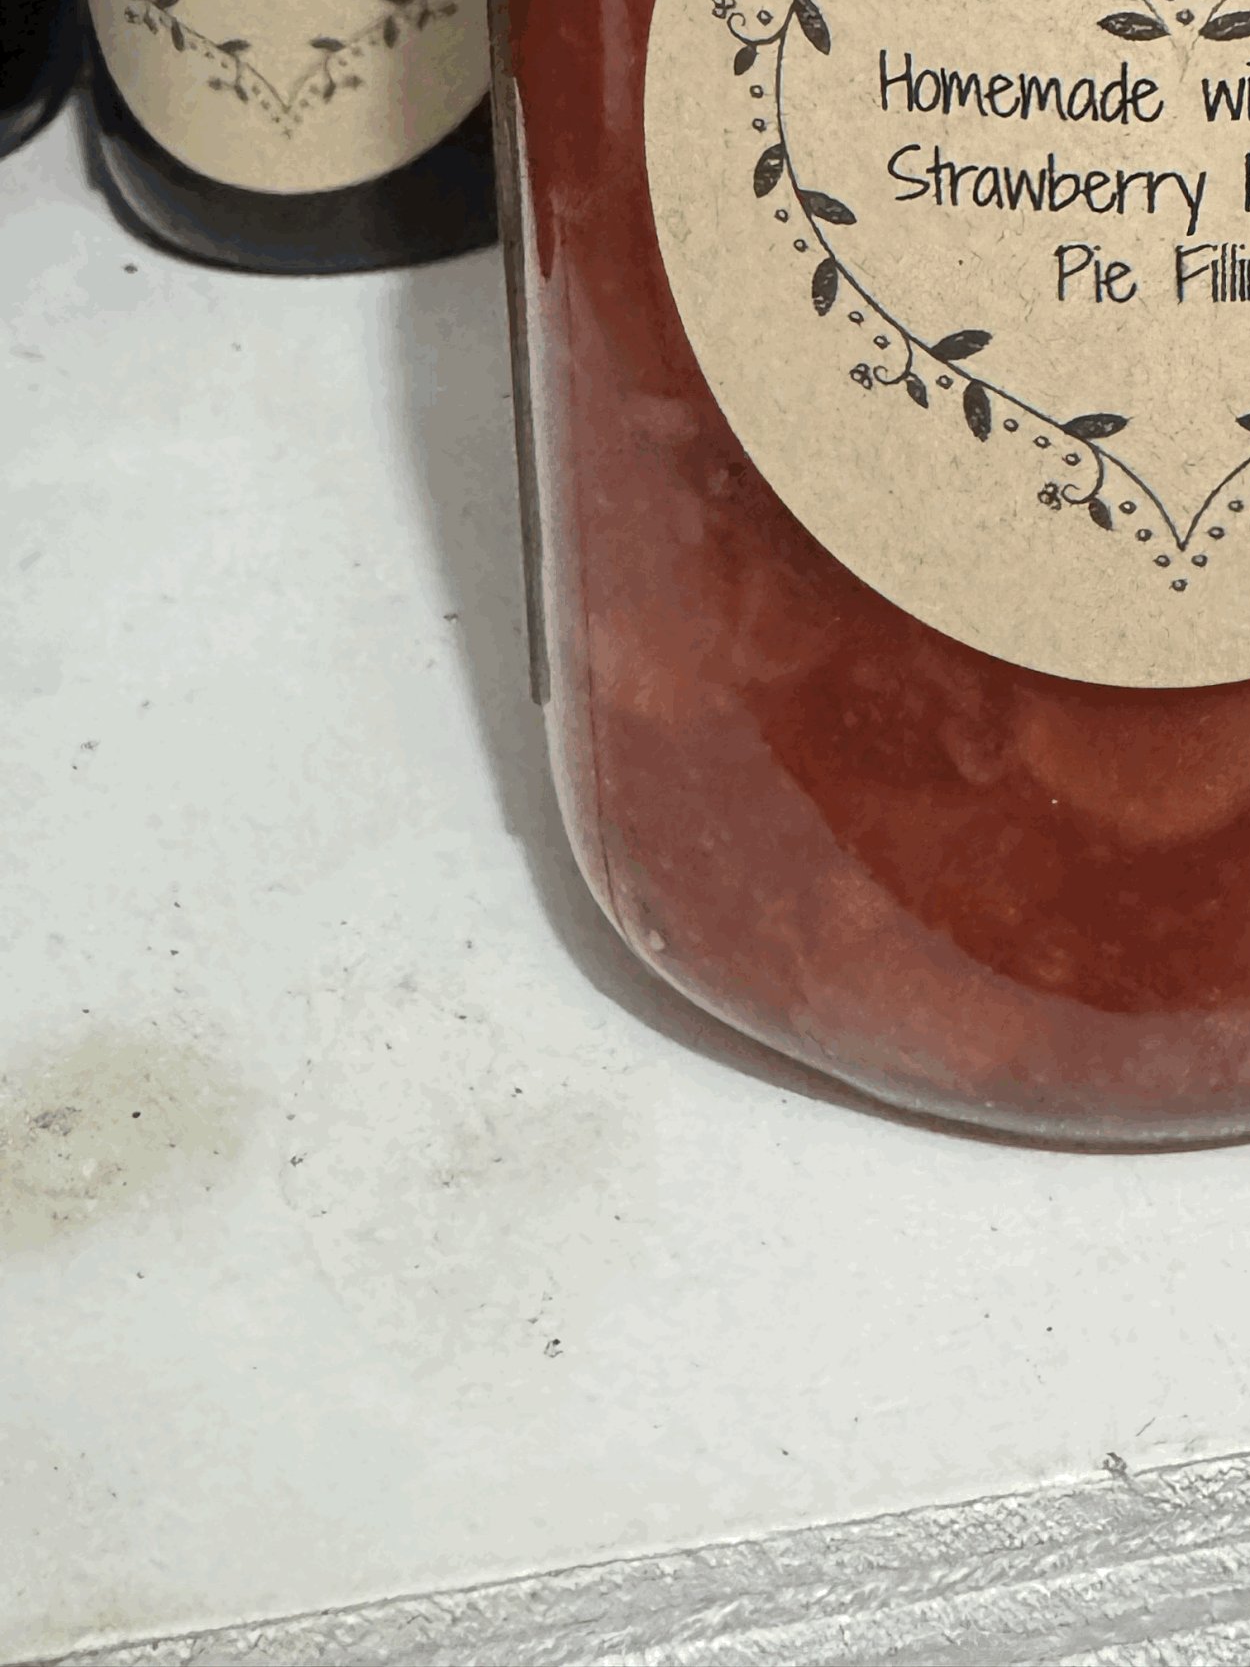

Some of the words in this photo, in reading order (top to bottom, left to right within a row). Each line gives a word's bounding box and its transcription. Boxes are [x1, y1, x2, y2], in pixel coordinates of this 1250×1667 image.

[879, 49, 1164, 124] Homemade
[887, 144, 1207, 236] Strawberry
[1053, 243, 1137, 304] Pie
